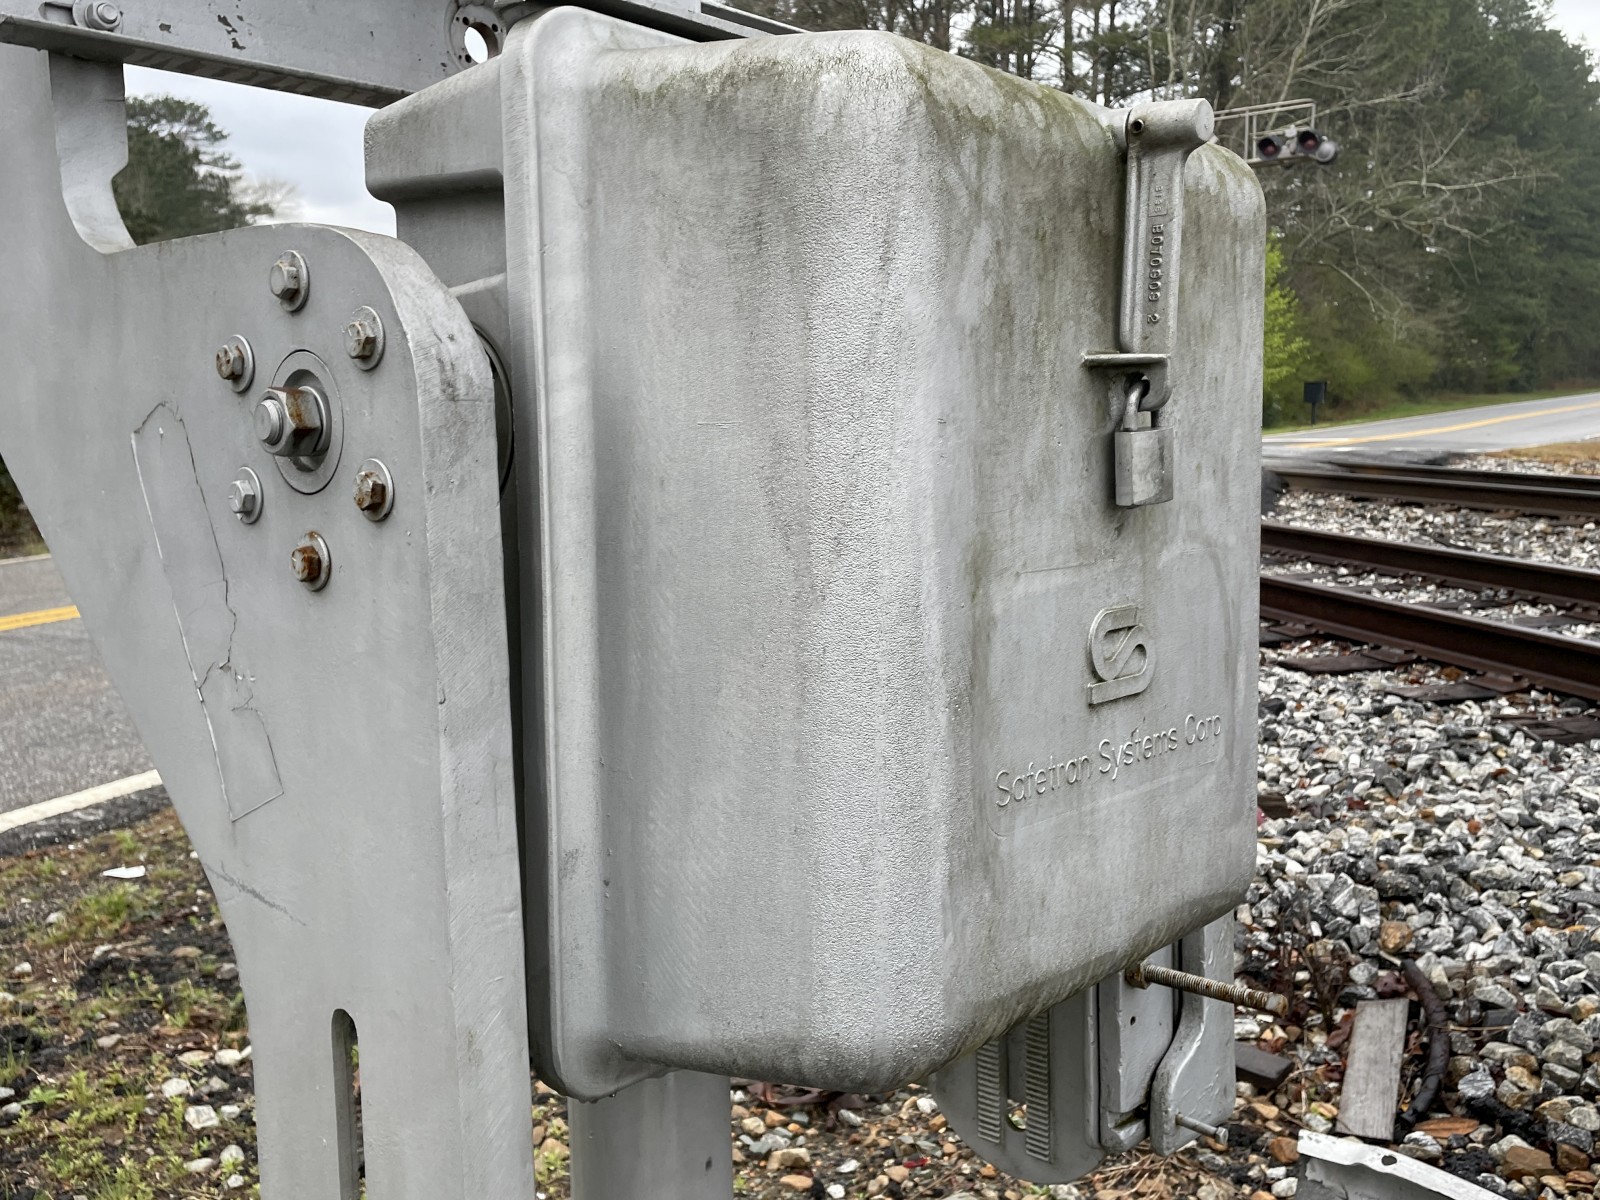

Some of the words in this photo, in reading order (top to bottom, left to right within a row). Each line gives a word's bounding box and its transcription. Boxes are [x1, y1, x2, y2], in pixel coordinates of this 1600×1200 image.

[1146, 311, 1160, 324] 2
[995, 755, 1093, 808] Safetran
[1098, 726, 1178, 781] Systems
